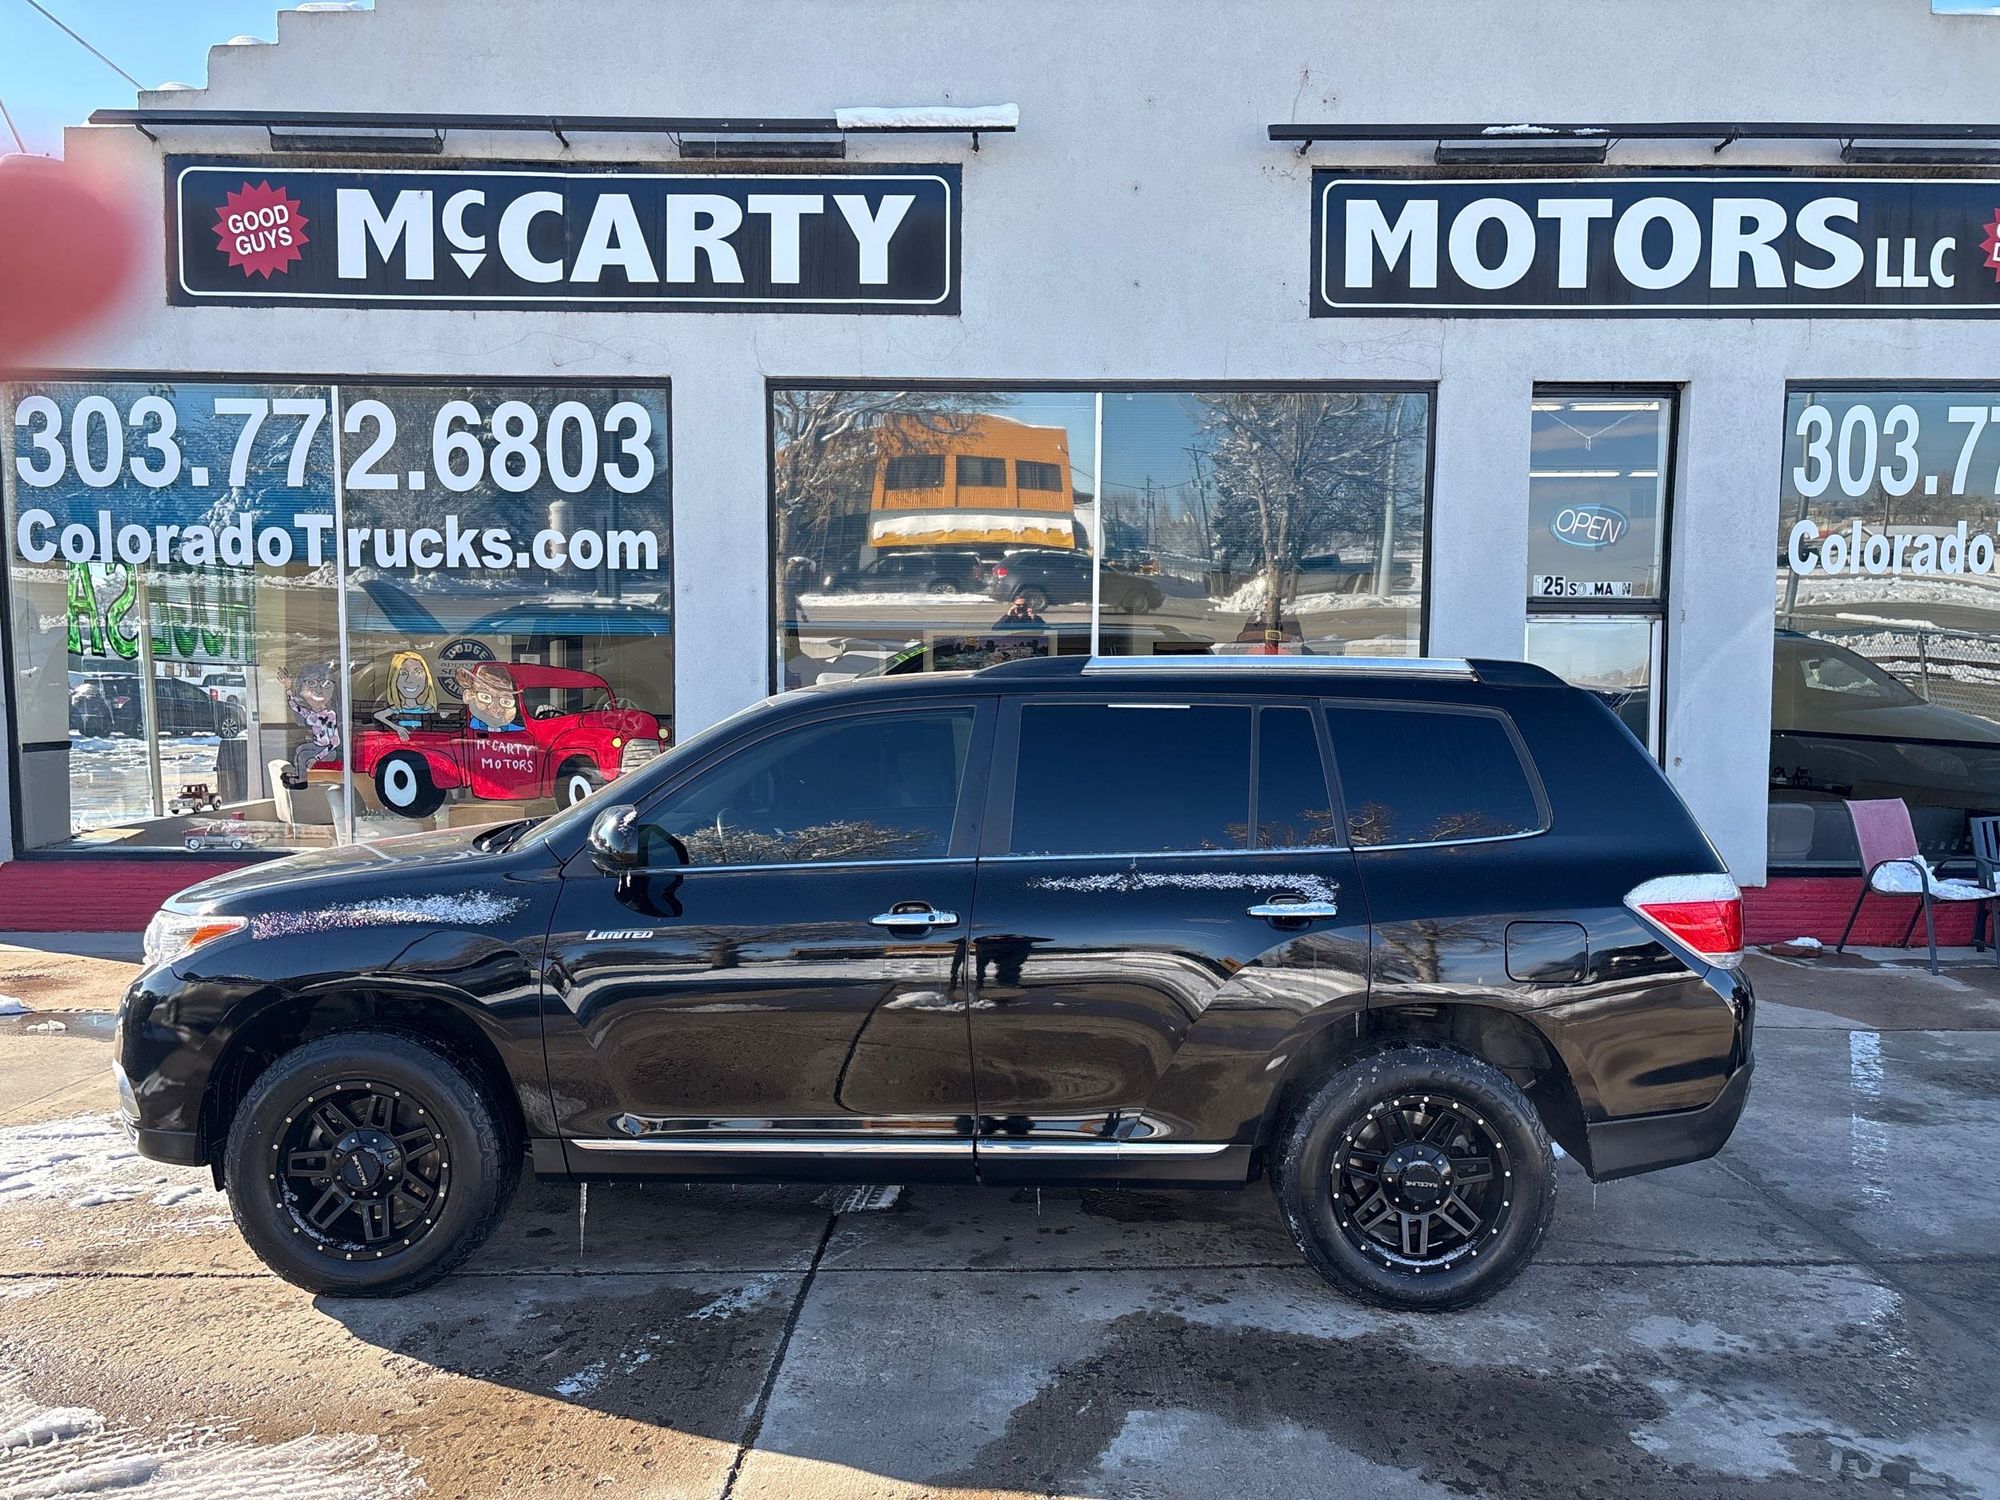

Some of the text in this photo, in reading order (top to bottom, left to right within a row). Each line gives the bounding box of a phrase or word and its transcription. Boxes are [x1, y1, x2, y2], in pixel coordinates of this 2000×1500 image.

[228, 204, 289, 234] GOOD
[235, 226, 293, 255] GUYS
[336, 188, 917, 285] McCARTY
[1344, 197, 1956, 290] MOTORS LLC
[1793, 404, 2000, 498] 303.7
[1556, 509, 1622, 543] OPEN
[1788, 519, 2000, 576] Colorado
[446, 642, 489, 659] DODGE
[481, 758, 533, 773] MOTORS
